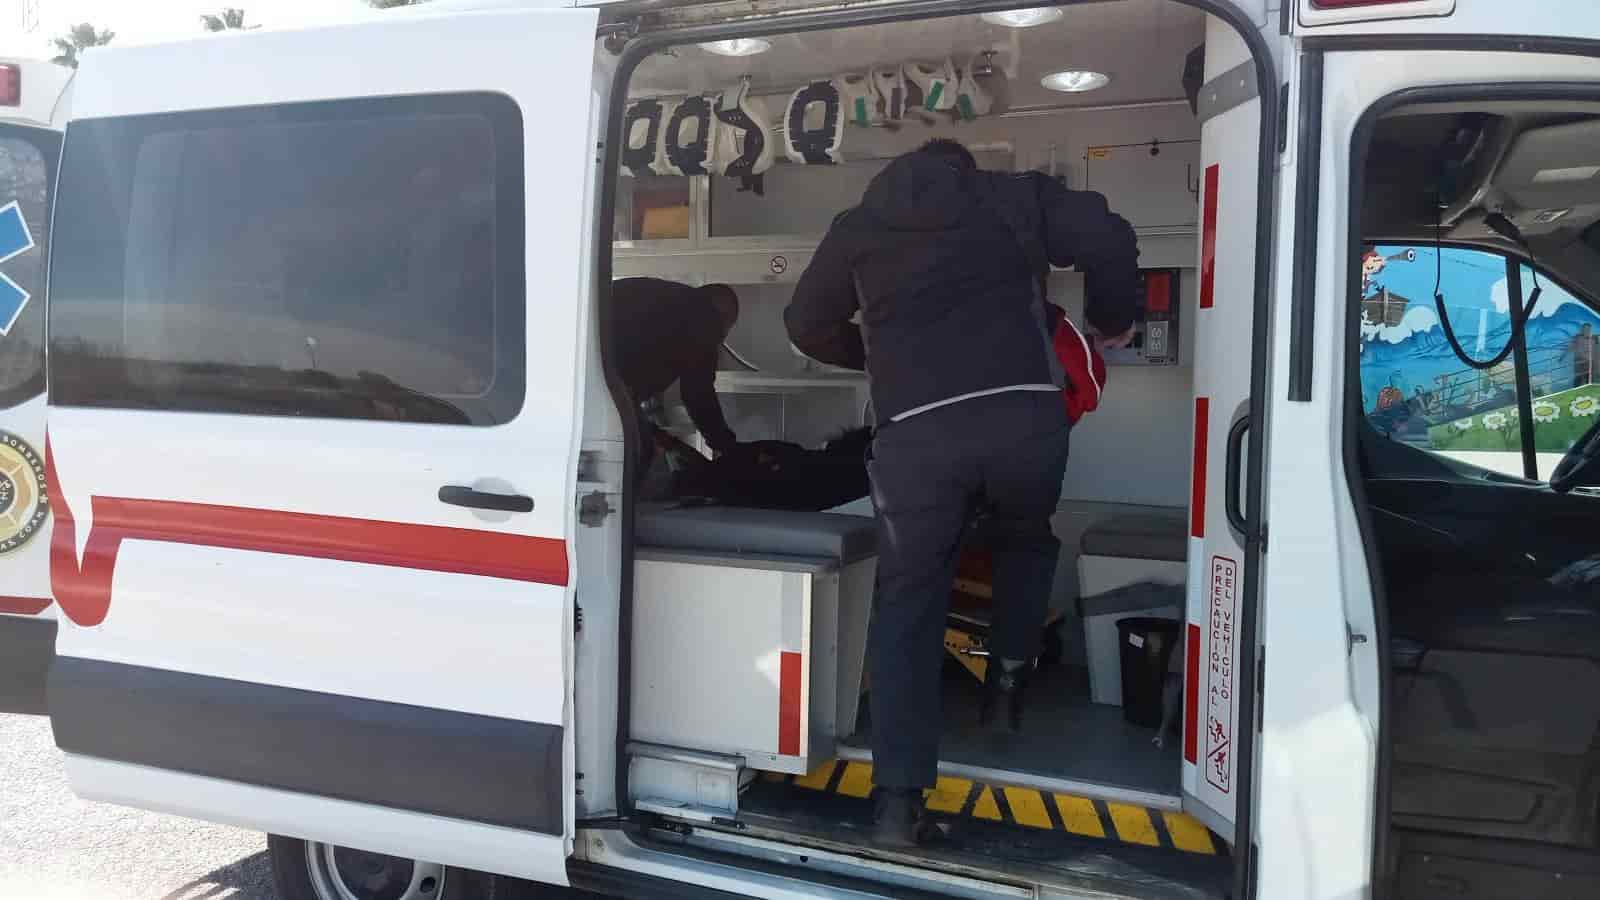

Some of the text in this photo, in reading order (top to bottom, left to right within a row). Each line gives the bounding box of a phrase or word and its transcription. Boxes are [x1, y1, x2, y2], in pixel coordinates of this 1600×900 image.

[1210, 564, 1223, 706] PRECAUCION AL
[1220, 566, 1233, 701] DEL VEHICULO
